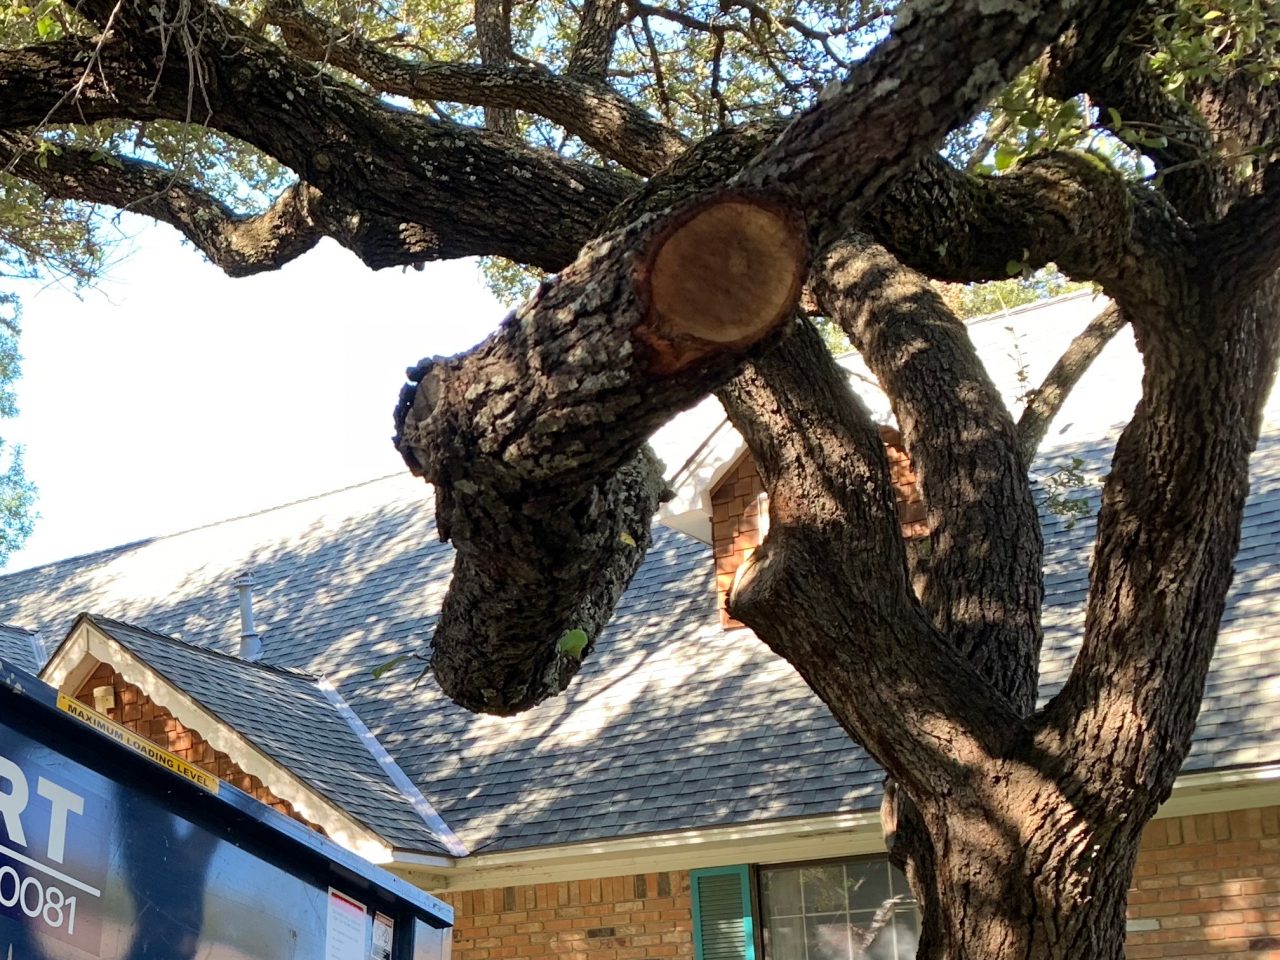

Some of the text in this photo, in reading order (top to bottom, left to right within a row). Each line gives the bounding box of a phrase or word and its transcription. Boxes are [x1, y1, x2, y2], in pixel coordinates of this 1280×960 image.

[67, 704, 209, 787] MAXIMUM LOADING LEVEL
